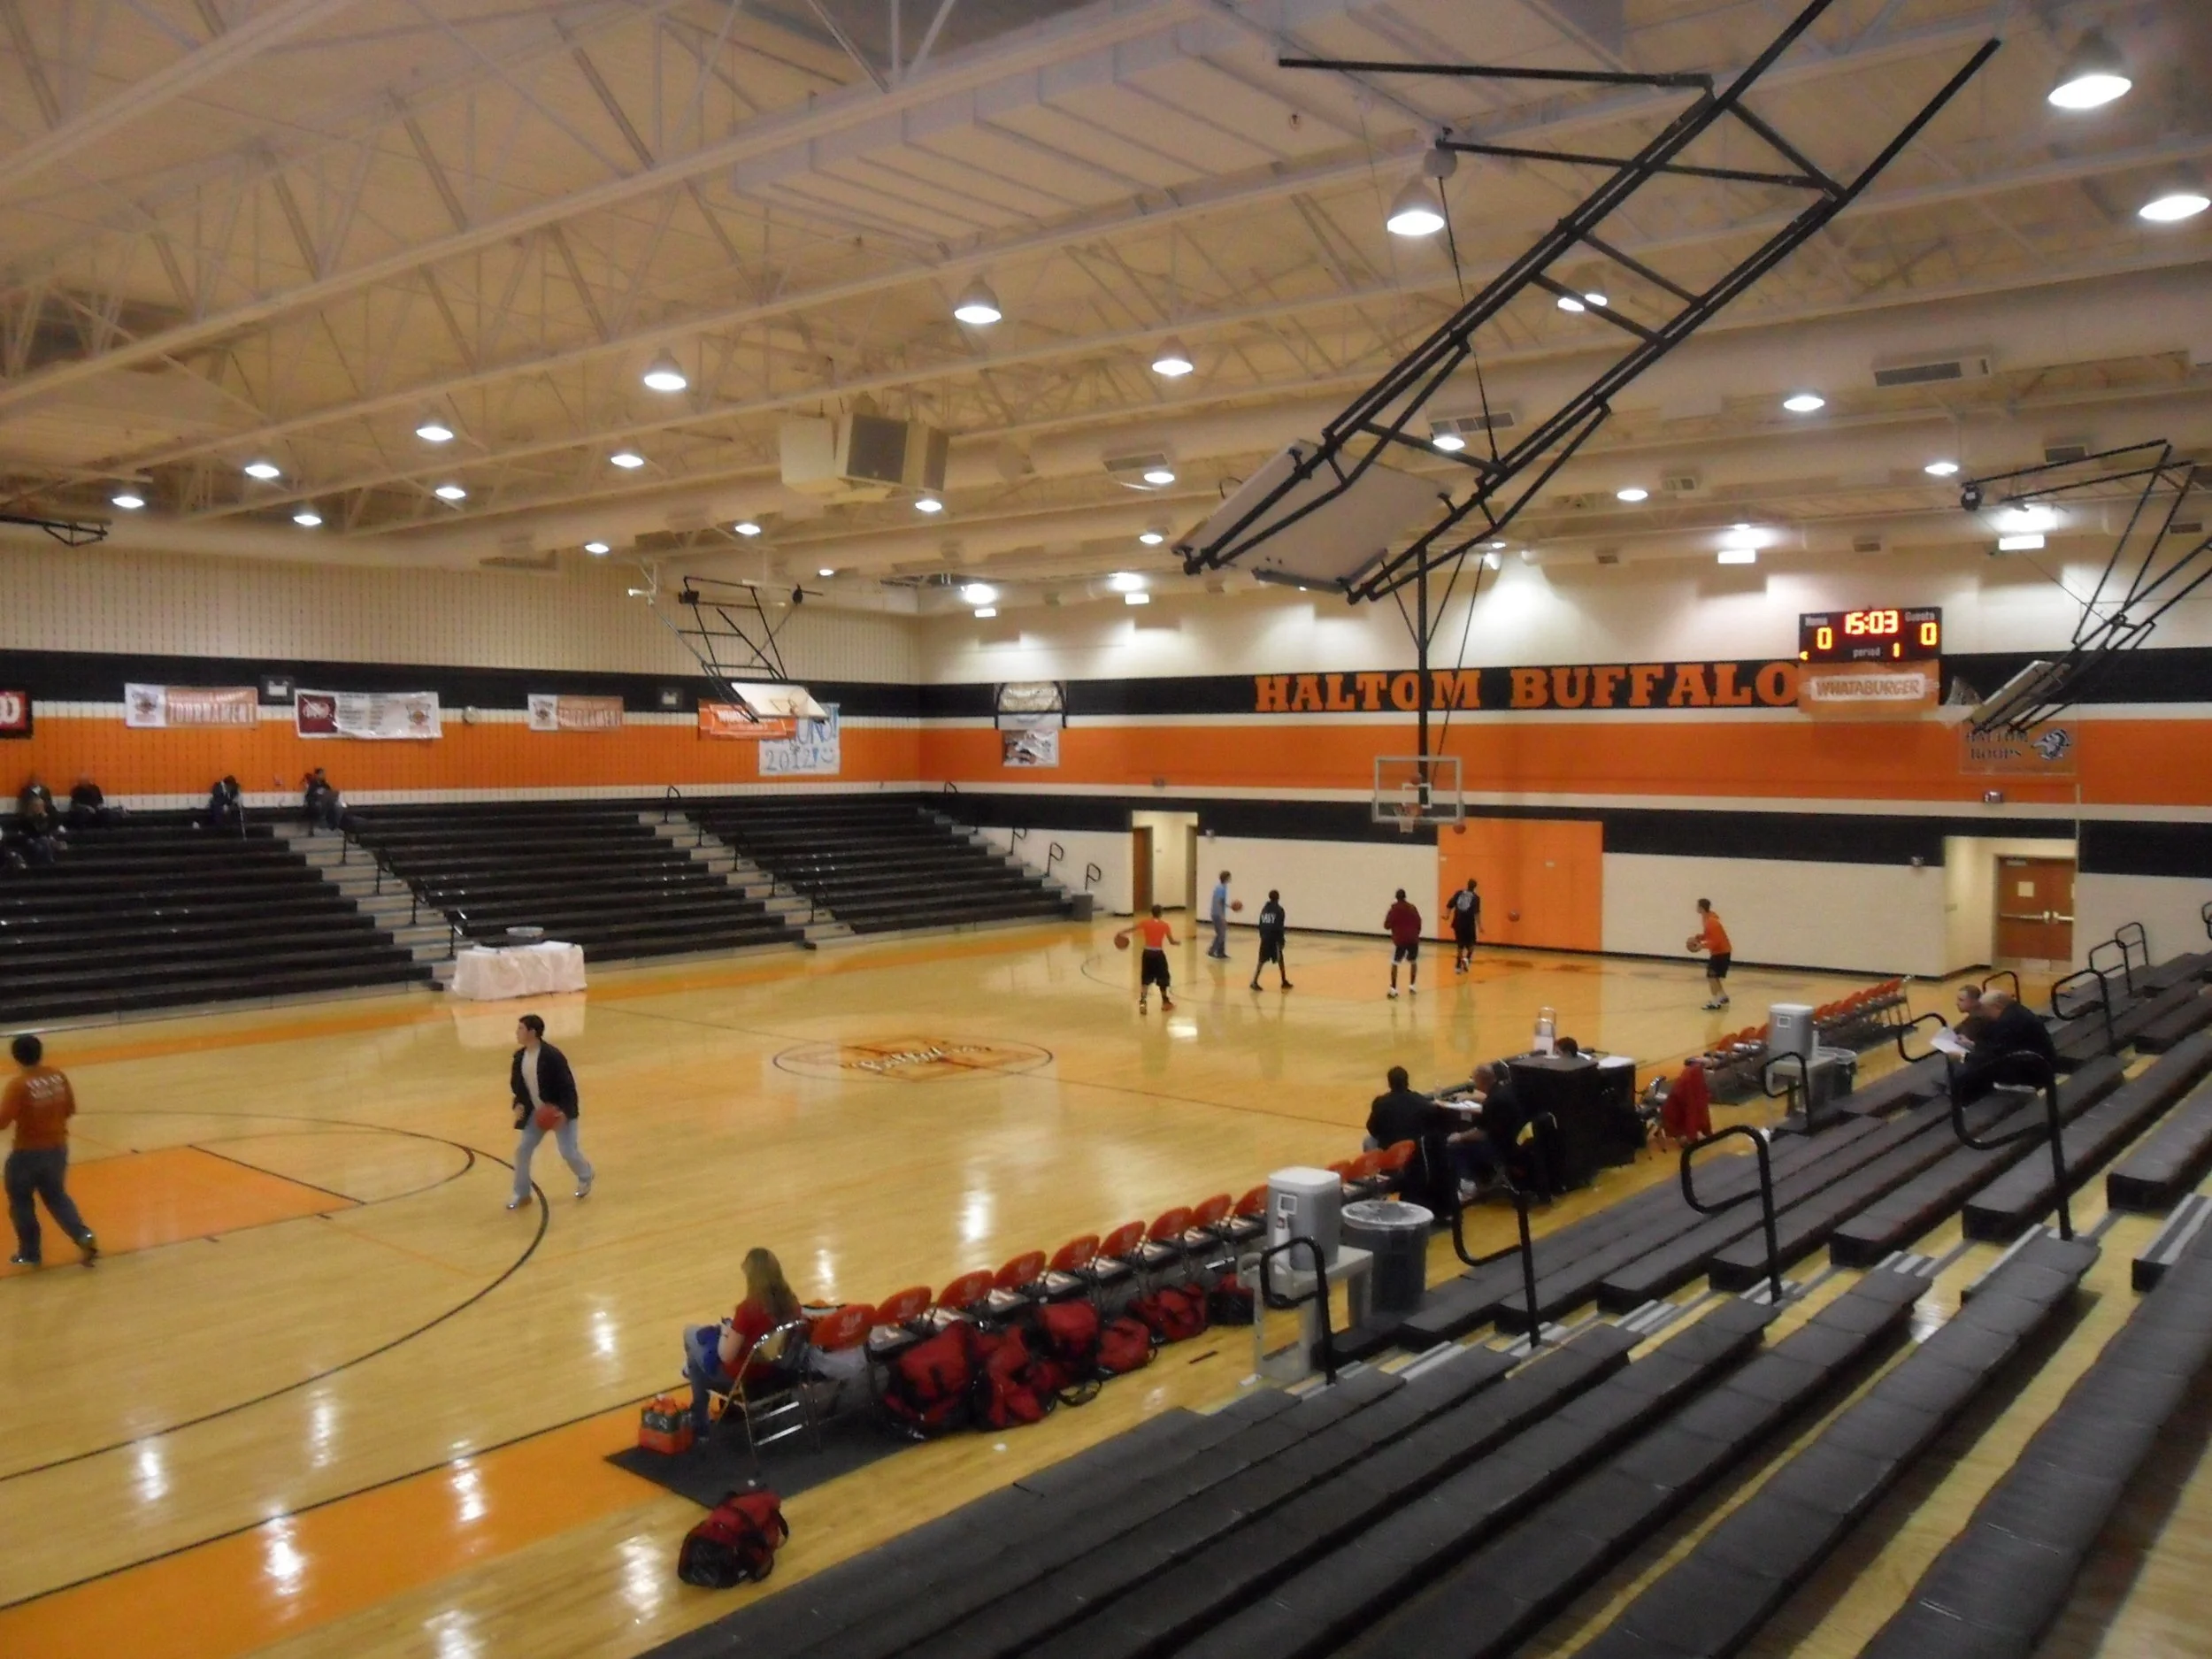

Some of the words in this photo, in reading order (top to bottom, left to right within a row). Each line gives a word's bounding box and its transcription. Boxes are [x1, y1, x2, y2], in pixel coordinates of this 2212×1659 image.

[1845, 610, 1898, 634] 15:03
[1816, 626, 1832, 649] 0
[1920, 622, 1937, 646] 0
[1893, 642, 1900, 657] 1
[1254, 669, 1480, 711] HALTOM
[1816, 679, 1919, 697] WHATABURGER
